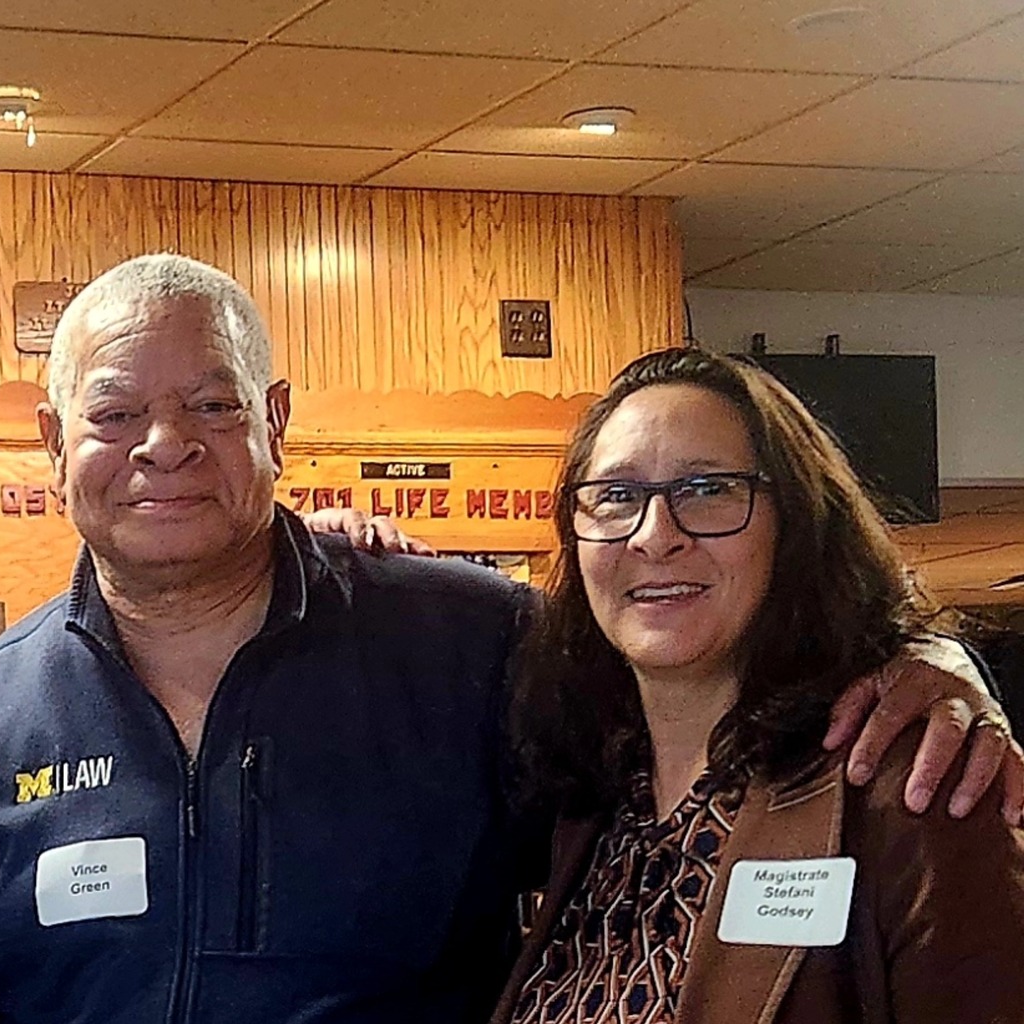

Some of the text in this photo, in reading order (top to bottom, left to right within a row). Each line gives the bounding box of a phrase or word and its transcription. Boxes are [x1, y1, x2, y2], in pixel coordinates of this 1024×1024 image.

[386, 464, 426, 477] ACTIVE
[289, 487, 352, 512] 701
[371, 487, 451, 519] LIFE
[466, 488, 554, 520] MEMB
[63, 755, 114, 792] LAW
[71, 863, 109, 877] Vince
[753, 869, 830, 885] Magistrate
[70, 880, 111, 895] Green
[763, 886, 816, 899] Stefani
[756, 904, 815, 920] Godsey
